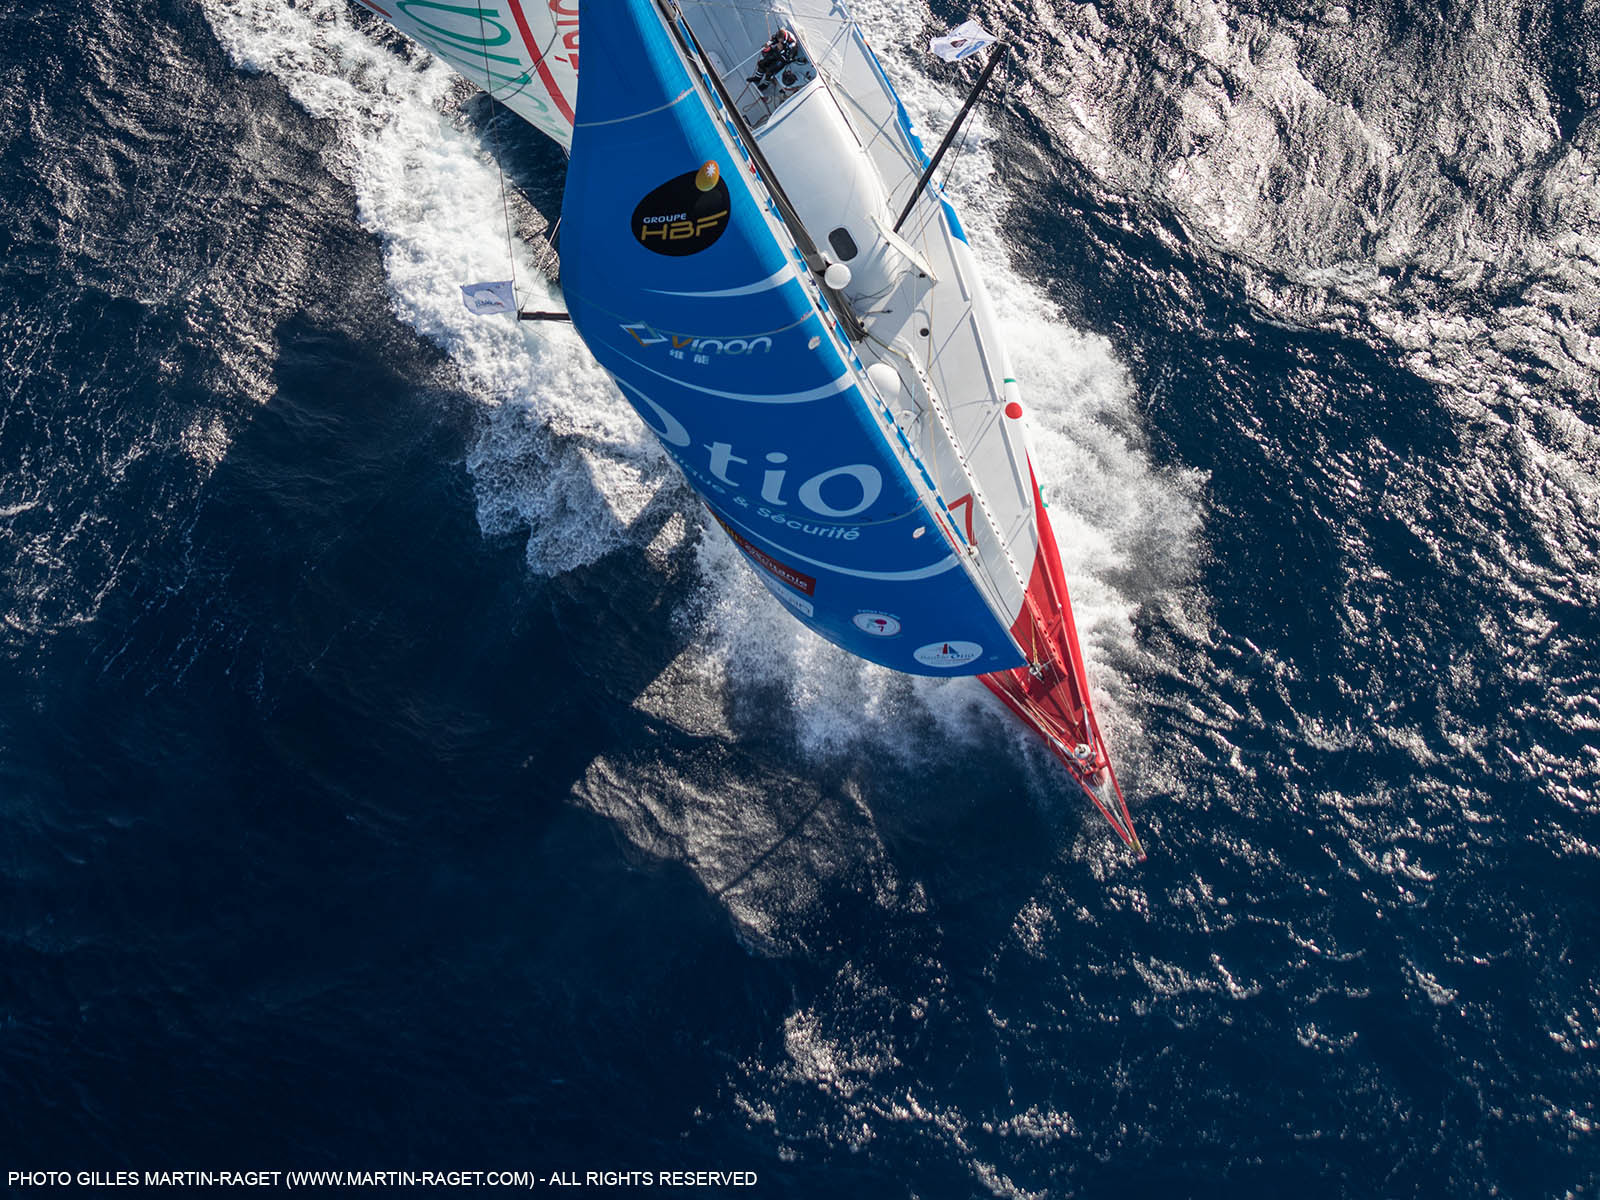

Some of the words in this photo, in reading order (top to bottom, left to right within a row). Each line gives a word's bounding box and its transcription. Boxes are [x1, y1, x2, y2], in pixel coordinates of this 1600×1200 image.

[642, 212, 687, 224] GROUPE
[641, 209, 728, 241] HBF
[733, 495, 749, 508] &
